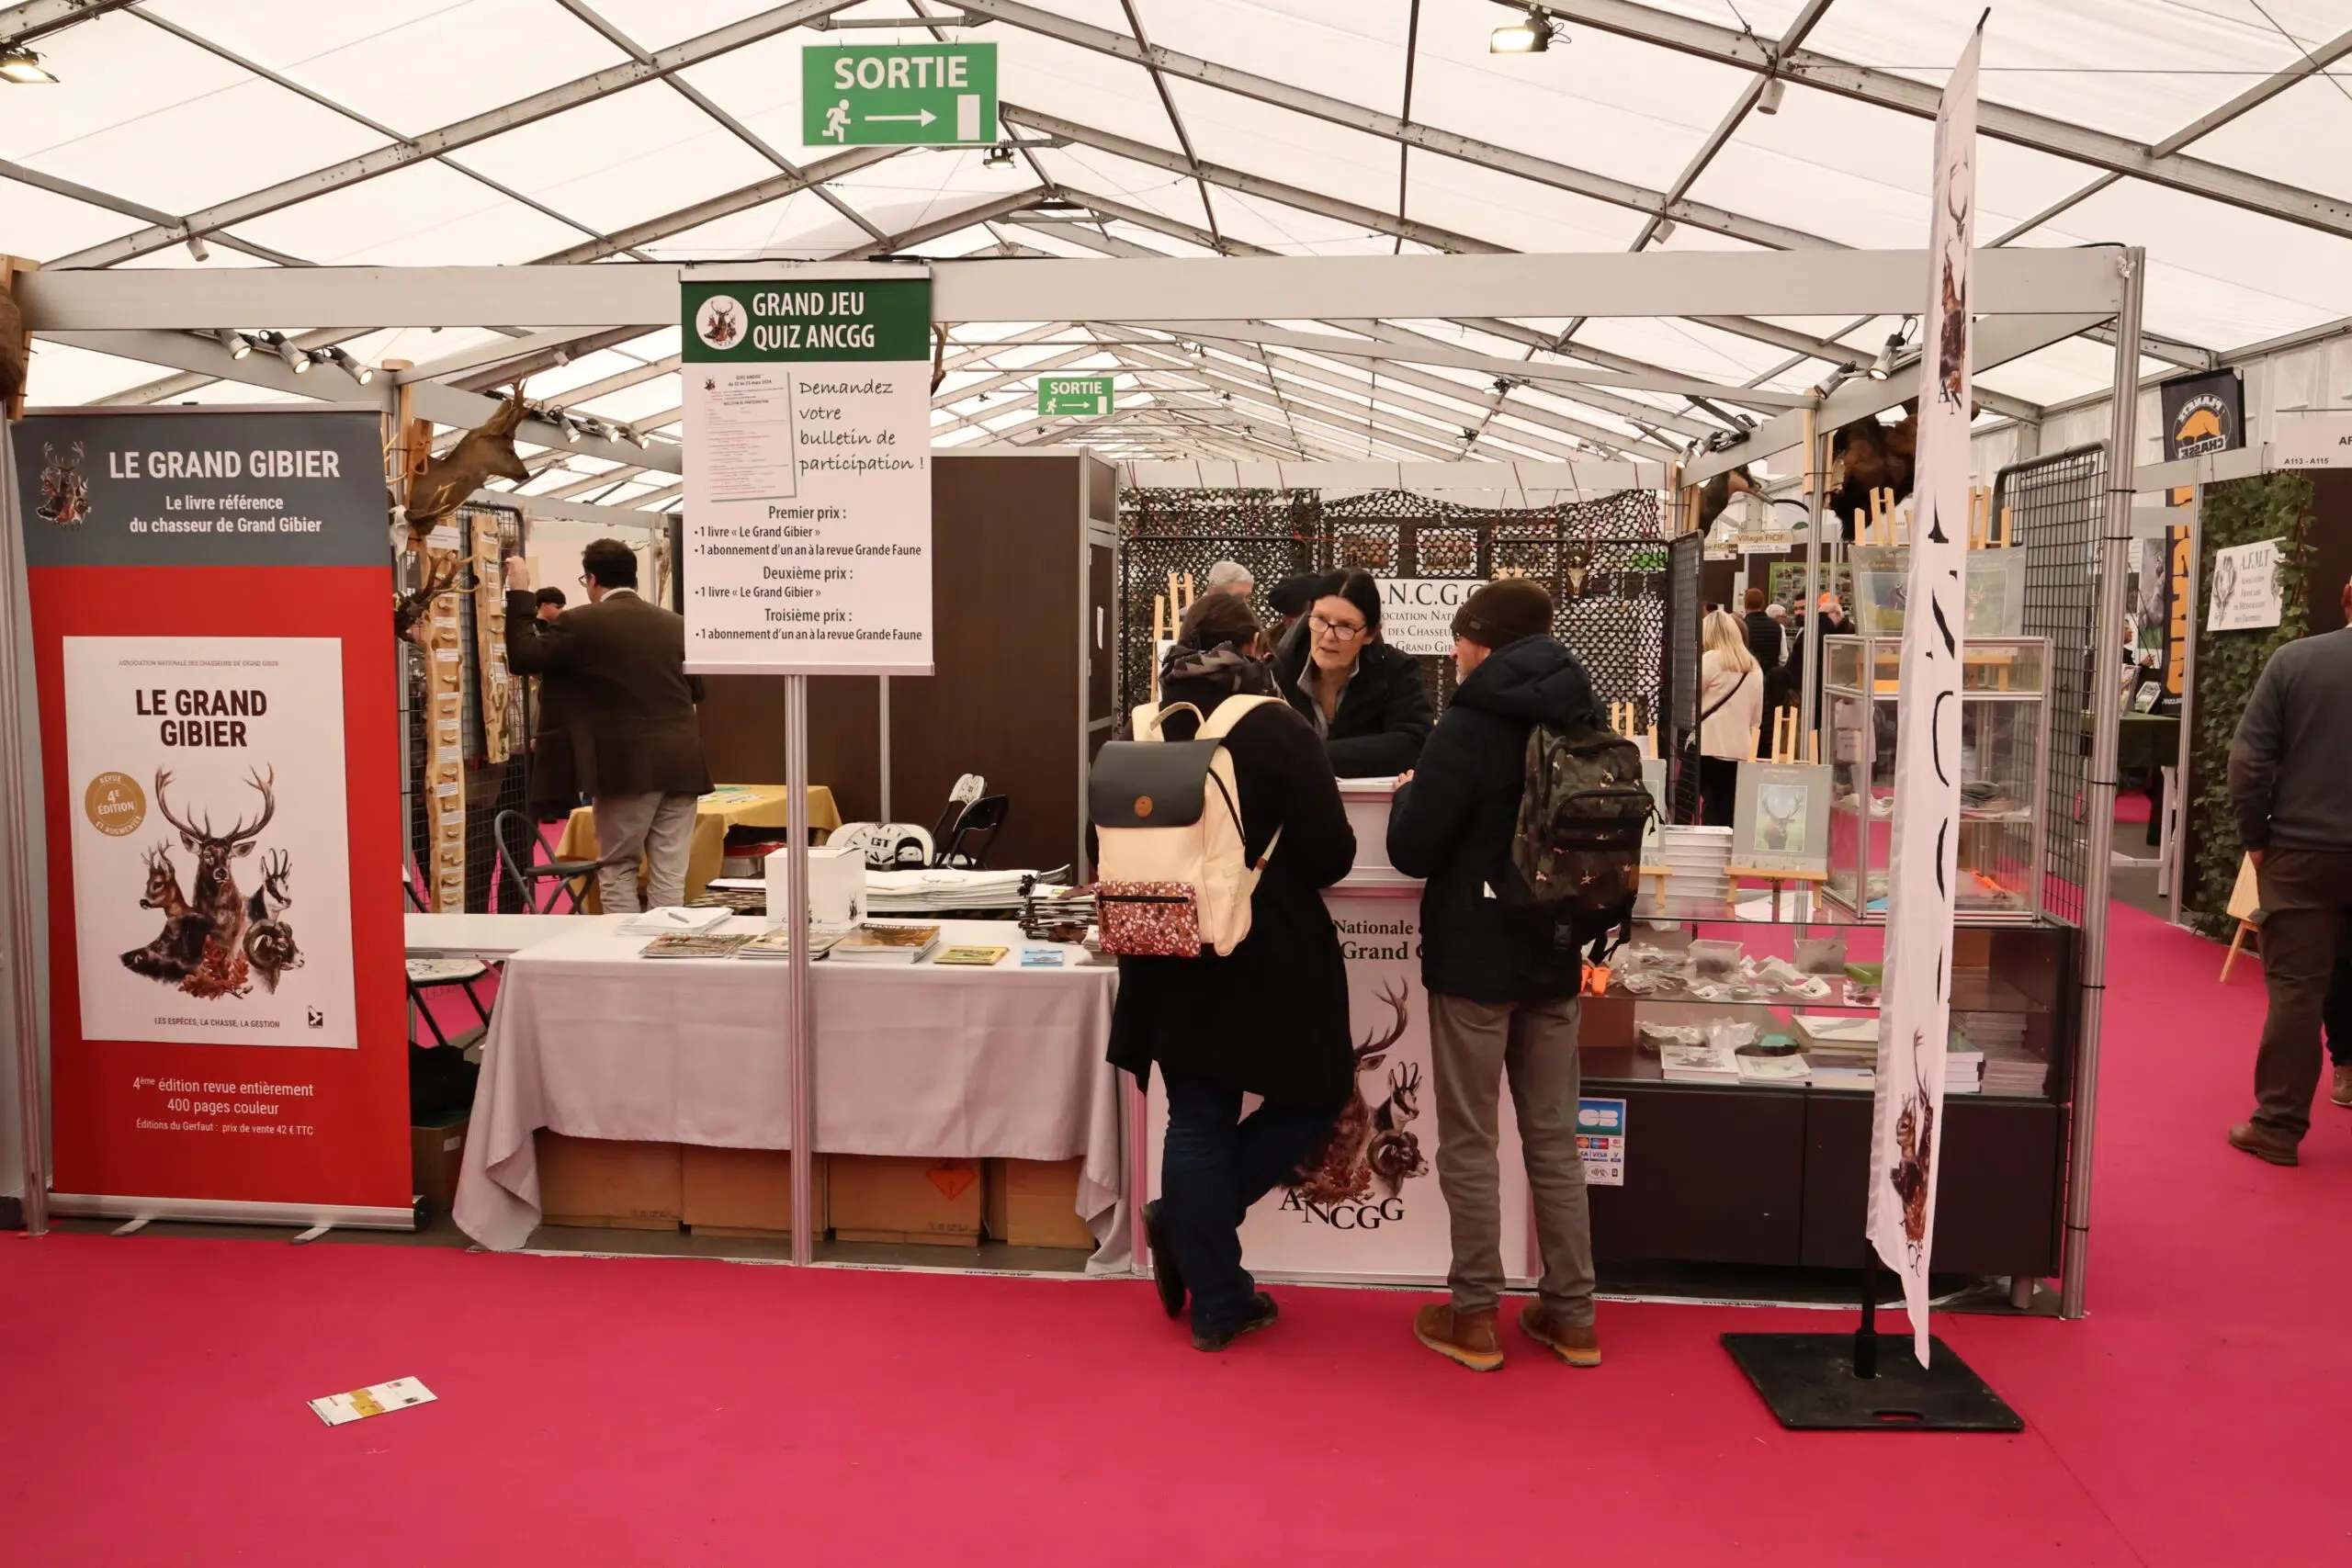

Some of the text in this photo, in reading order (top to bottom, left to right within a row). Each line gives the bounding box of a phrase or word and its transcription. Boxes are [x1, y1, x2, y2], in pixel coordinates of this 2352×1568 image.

[834, 55, 968, 90] SORTIE
[752, 291, 865, 317] GRAND JEU
[753, 324, 876, 350] QUIZ ANCGG
[799, 380, 893, 395] Demandez
[1050, 381, 1102, 395] SORTIE
[799, 407, 842, 420] votre
[800, 430, 896, 446] bulletin de
[109, 450, 340, 478] LE GRAND GIBIER
[798, 455, 914, 476] participation
[165, 495, 284, 511] Le livre référence
[769, 505, 814, 520] Premier
[817, 506, 840, 523] prix
[130, 517, 322, 533] du chasseur de Grand Gibier
[708, 526, 729, 537] livre
[740, 526, 751, 537] Le
[752, 526, 782, 537] Grand
[784, 526, 812, 537] Gibier
[1737, 535, 1763, 543] Village
[707, 545, 770, 555] abonnement
[808, 545, 815, 555] à
[817, 544, 824, 555] la
[855, 544, 889, 556] Grande
[892, 545, 922, 556] Faune
[763, 566, 821, 580] Deuxième
[824, 567, 847, 583] prix
[708, 586, 730, 597] livre
[740, 586, 751, 597] Le
[753, 586, 782, 597] Grand
[785, 586, 813, 597] Gibier
[764, 608, 820, 622] Troisième
[823, 609, 846, 625] prix
[1383, 612, 1427, 621] OCIATION
[708, 628, 770, 639] abonnement
[809, 628, 815, 639] à
[817, 628, 825, 639] la
[856, 628, 890, 639] Grande
[892, 628, 922, 640] Faune
[136, 689, 266, 716] LE GRAND
[161, 720, 247, 747] GIBIER
[97, 801, 134, 816] ÉDITION
[1333, 919, 1414, 935] Nationale
[1341, 942, 1408, 960] Grand
[133, 1077, 314, 1097] 4ème édition revue entièrement
[167, 1099, 279, 1116] 400 pages couleur
[136, 1118, 168, 1130] Éditions
[170, 1121, 181, 1131] du
[183, 1120, 213, 1132] Gerfaut
[222, 1122, 238, 1134] prix
[240, 1122, 250, 1134] de
[252, 1123, 275, 1134] vente
[277, 1124, 287, 1134] 42
[296, 1125, 313, 1135] TTC
[1279, 1188, 1405, 1229] ANCGG
